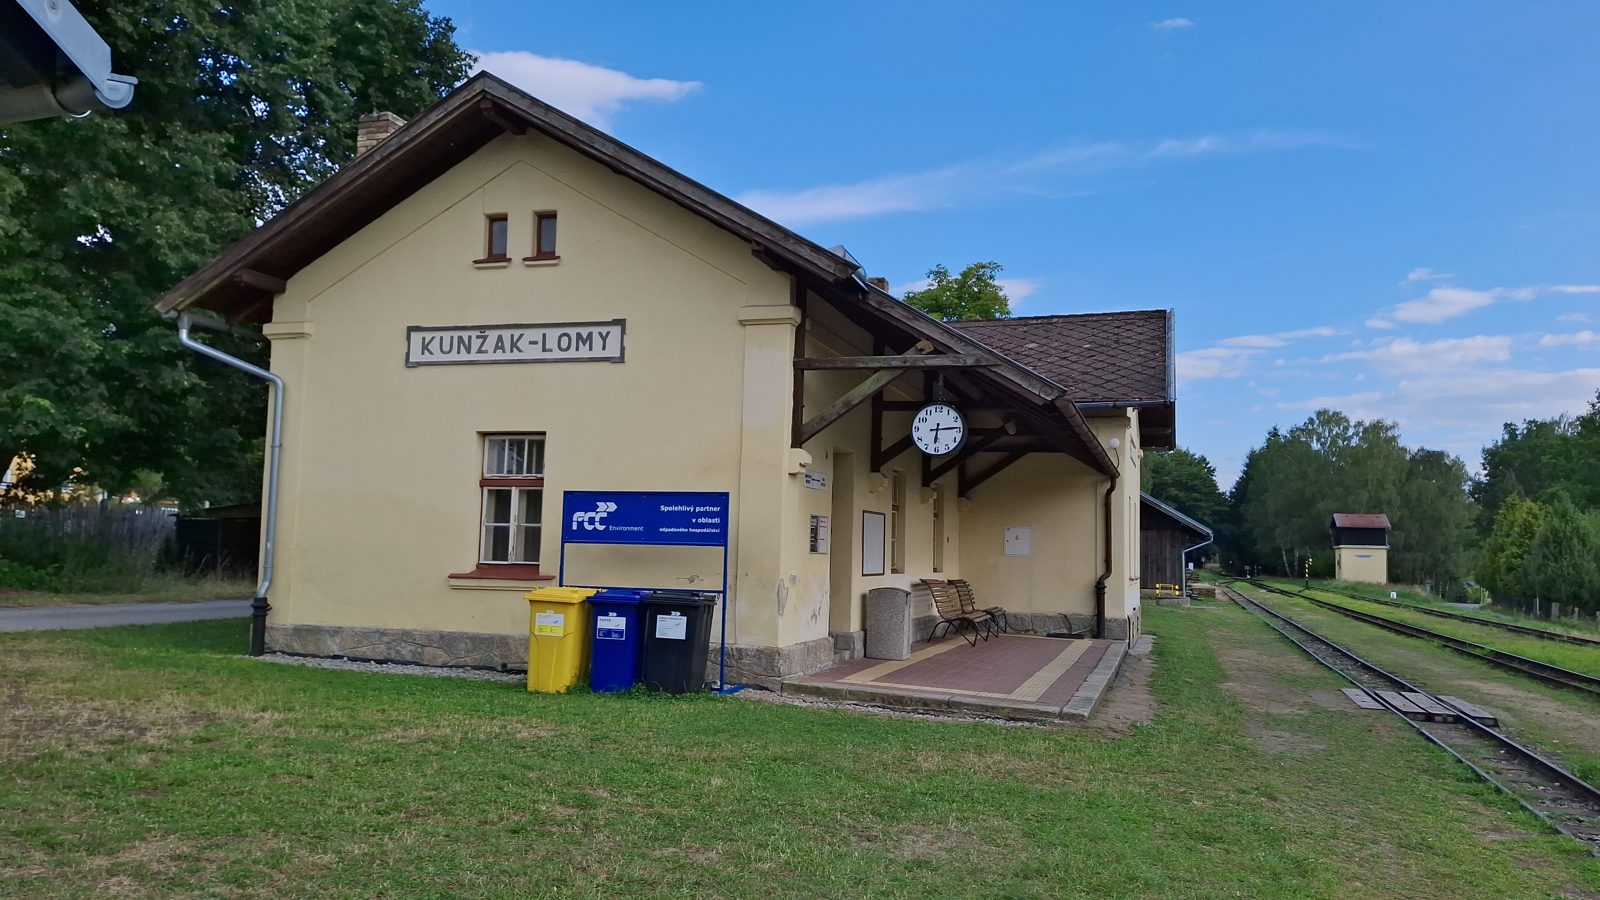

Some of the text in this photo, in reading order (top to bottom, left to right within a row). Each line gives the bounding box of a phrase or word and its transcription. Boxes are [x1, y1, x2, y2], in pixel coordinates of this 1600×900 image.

[421, 330, 611, 356] KUNŽAK-LOMY
[660, 505, 694, 513] Spolehlivý
[572, 511, 608, 530] FCC
